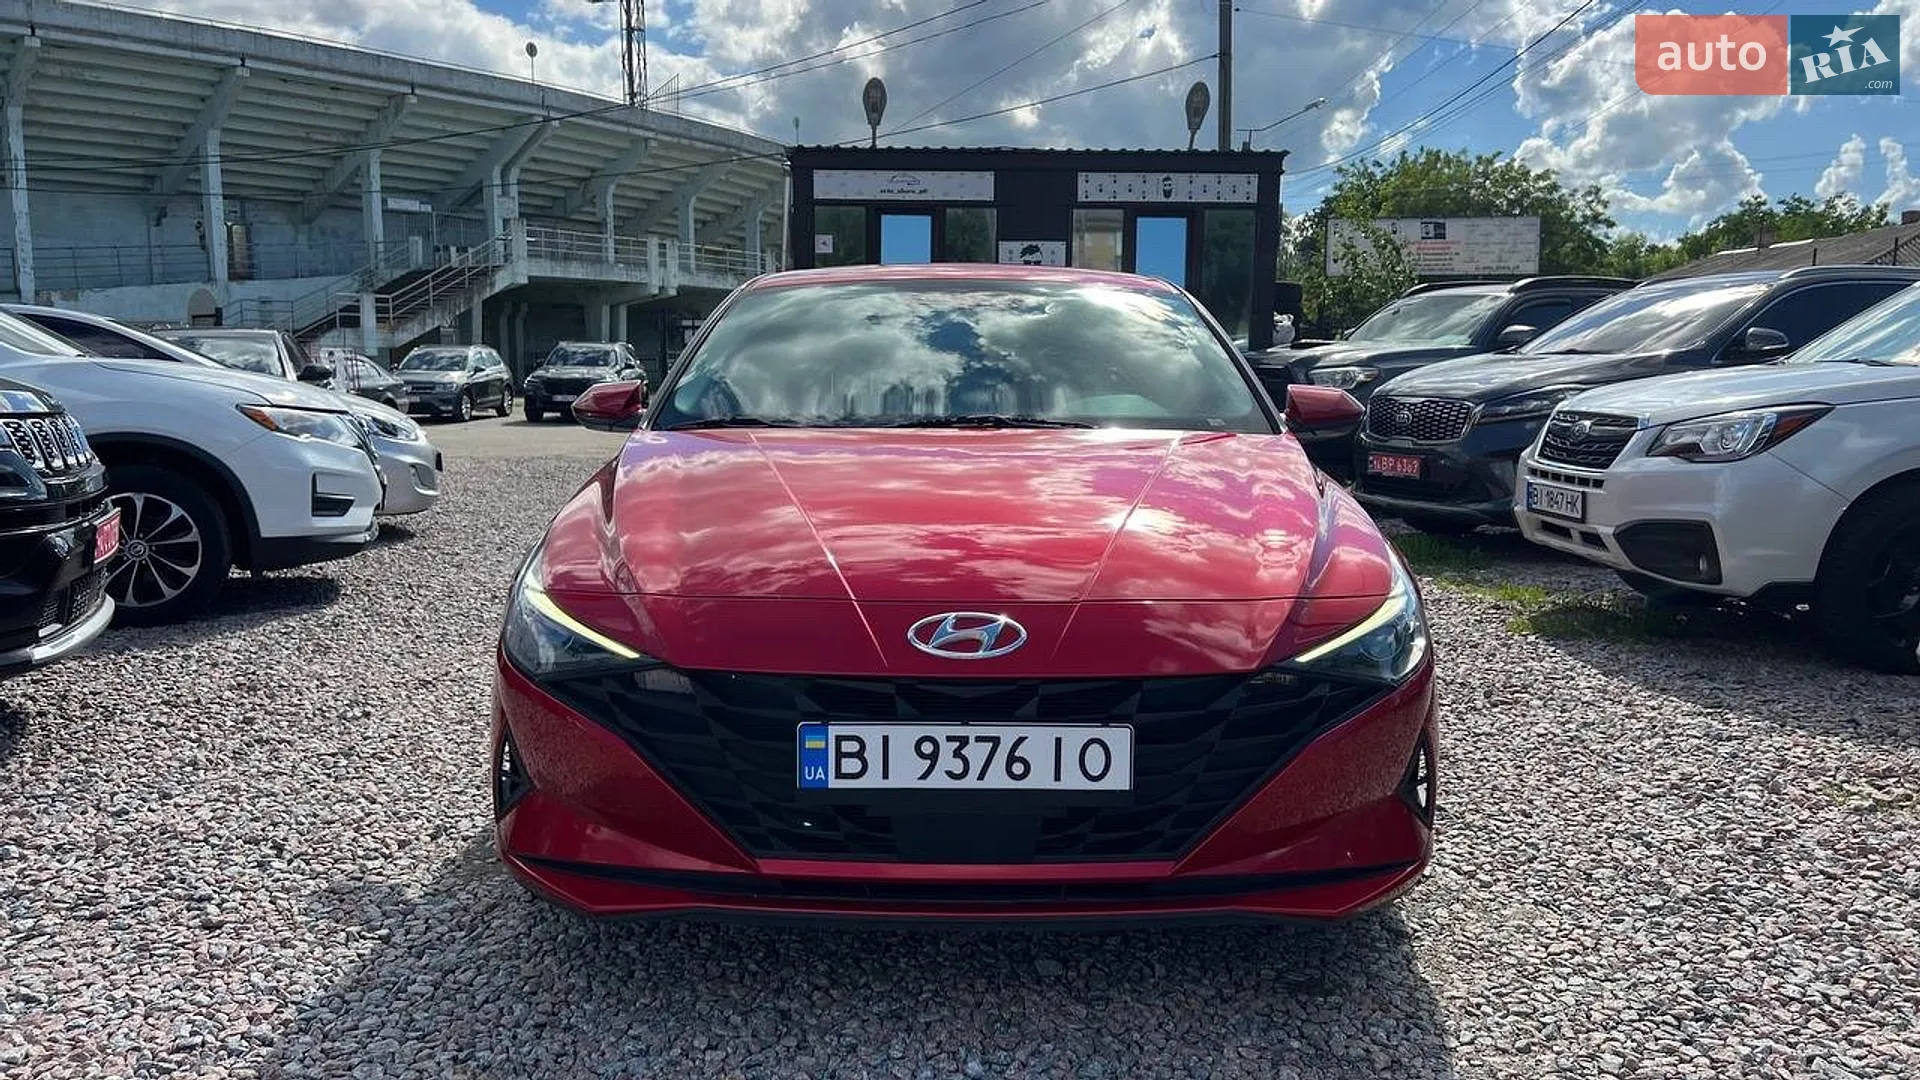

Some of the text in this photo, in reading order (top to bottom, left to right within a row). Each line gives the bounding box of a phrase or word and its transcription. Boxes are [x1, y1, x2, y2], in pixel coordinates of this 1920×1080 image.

[805, 766, 825, 780] UA
[834, 735, 889, 780] BI
[913, 735, 1031, 781] 9376
